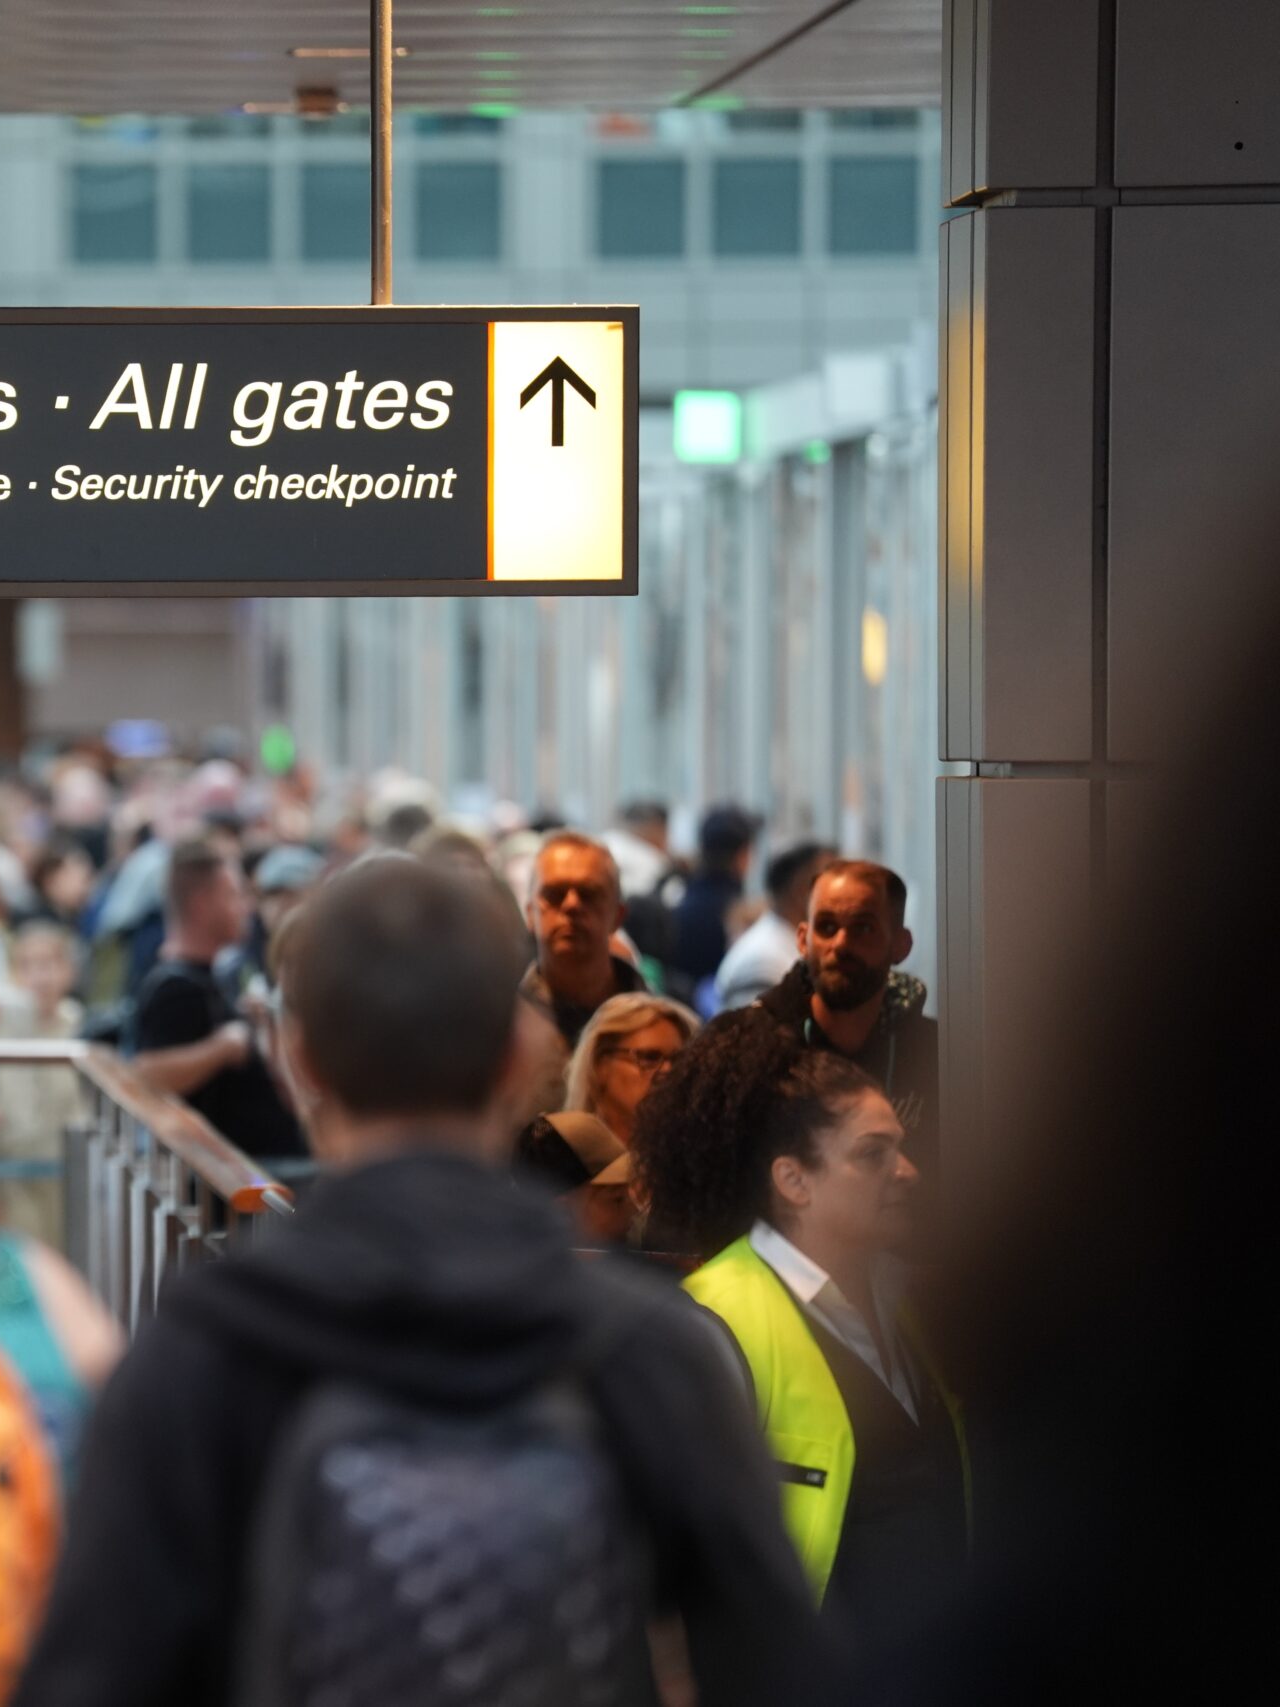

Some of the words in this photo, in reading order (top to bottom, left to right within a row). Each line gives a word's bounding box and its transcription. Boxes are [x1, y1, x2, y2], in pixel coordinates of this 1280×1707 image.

[88, 362, 208, 430] All
[229, 369, 454, 447] gates
[50, 463, 224, 508] Security
[233, 463, 458, 508] checkpoint
